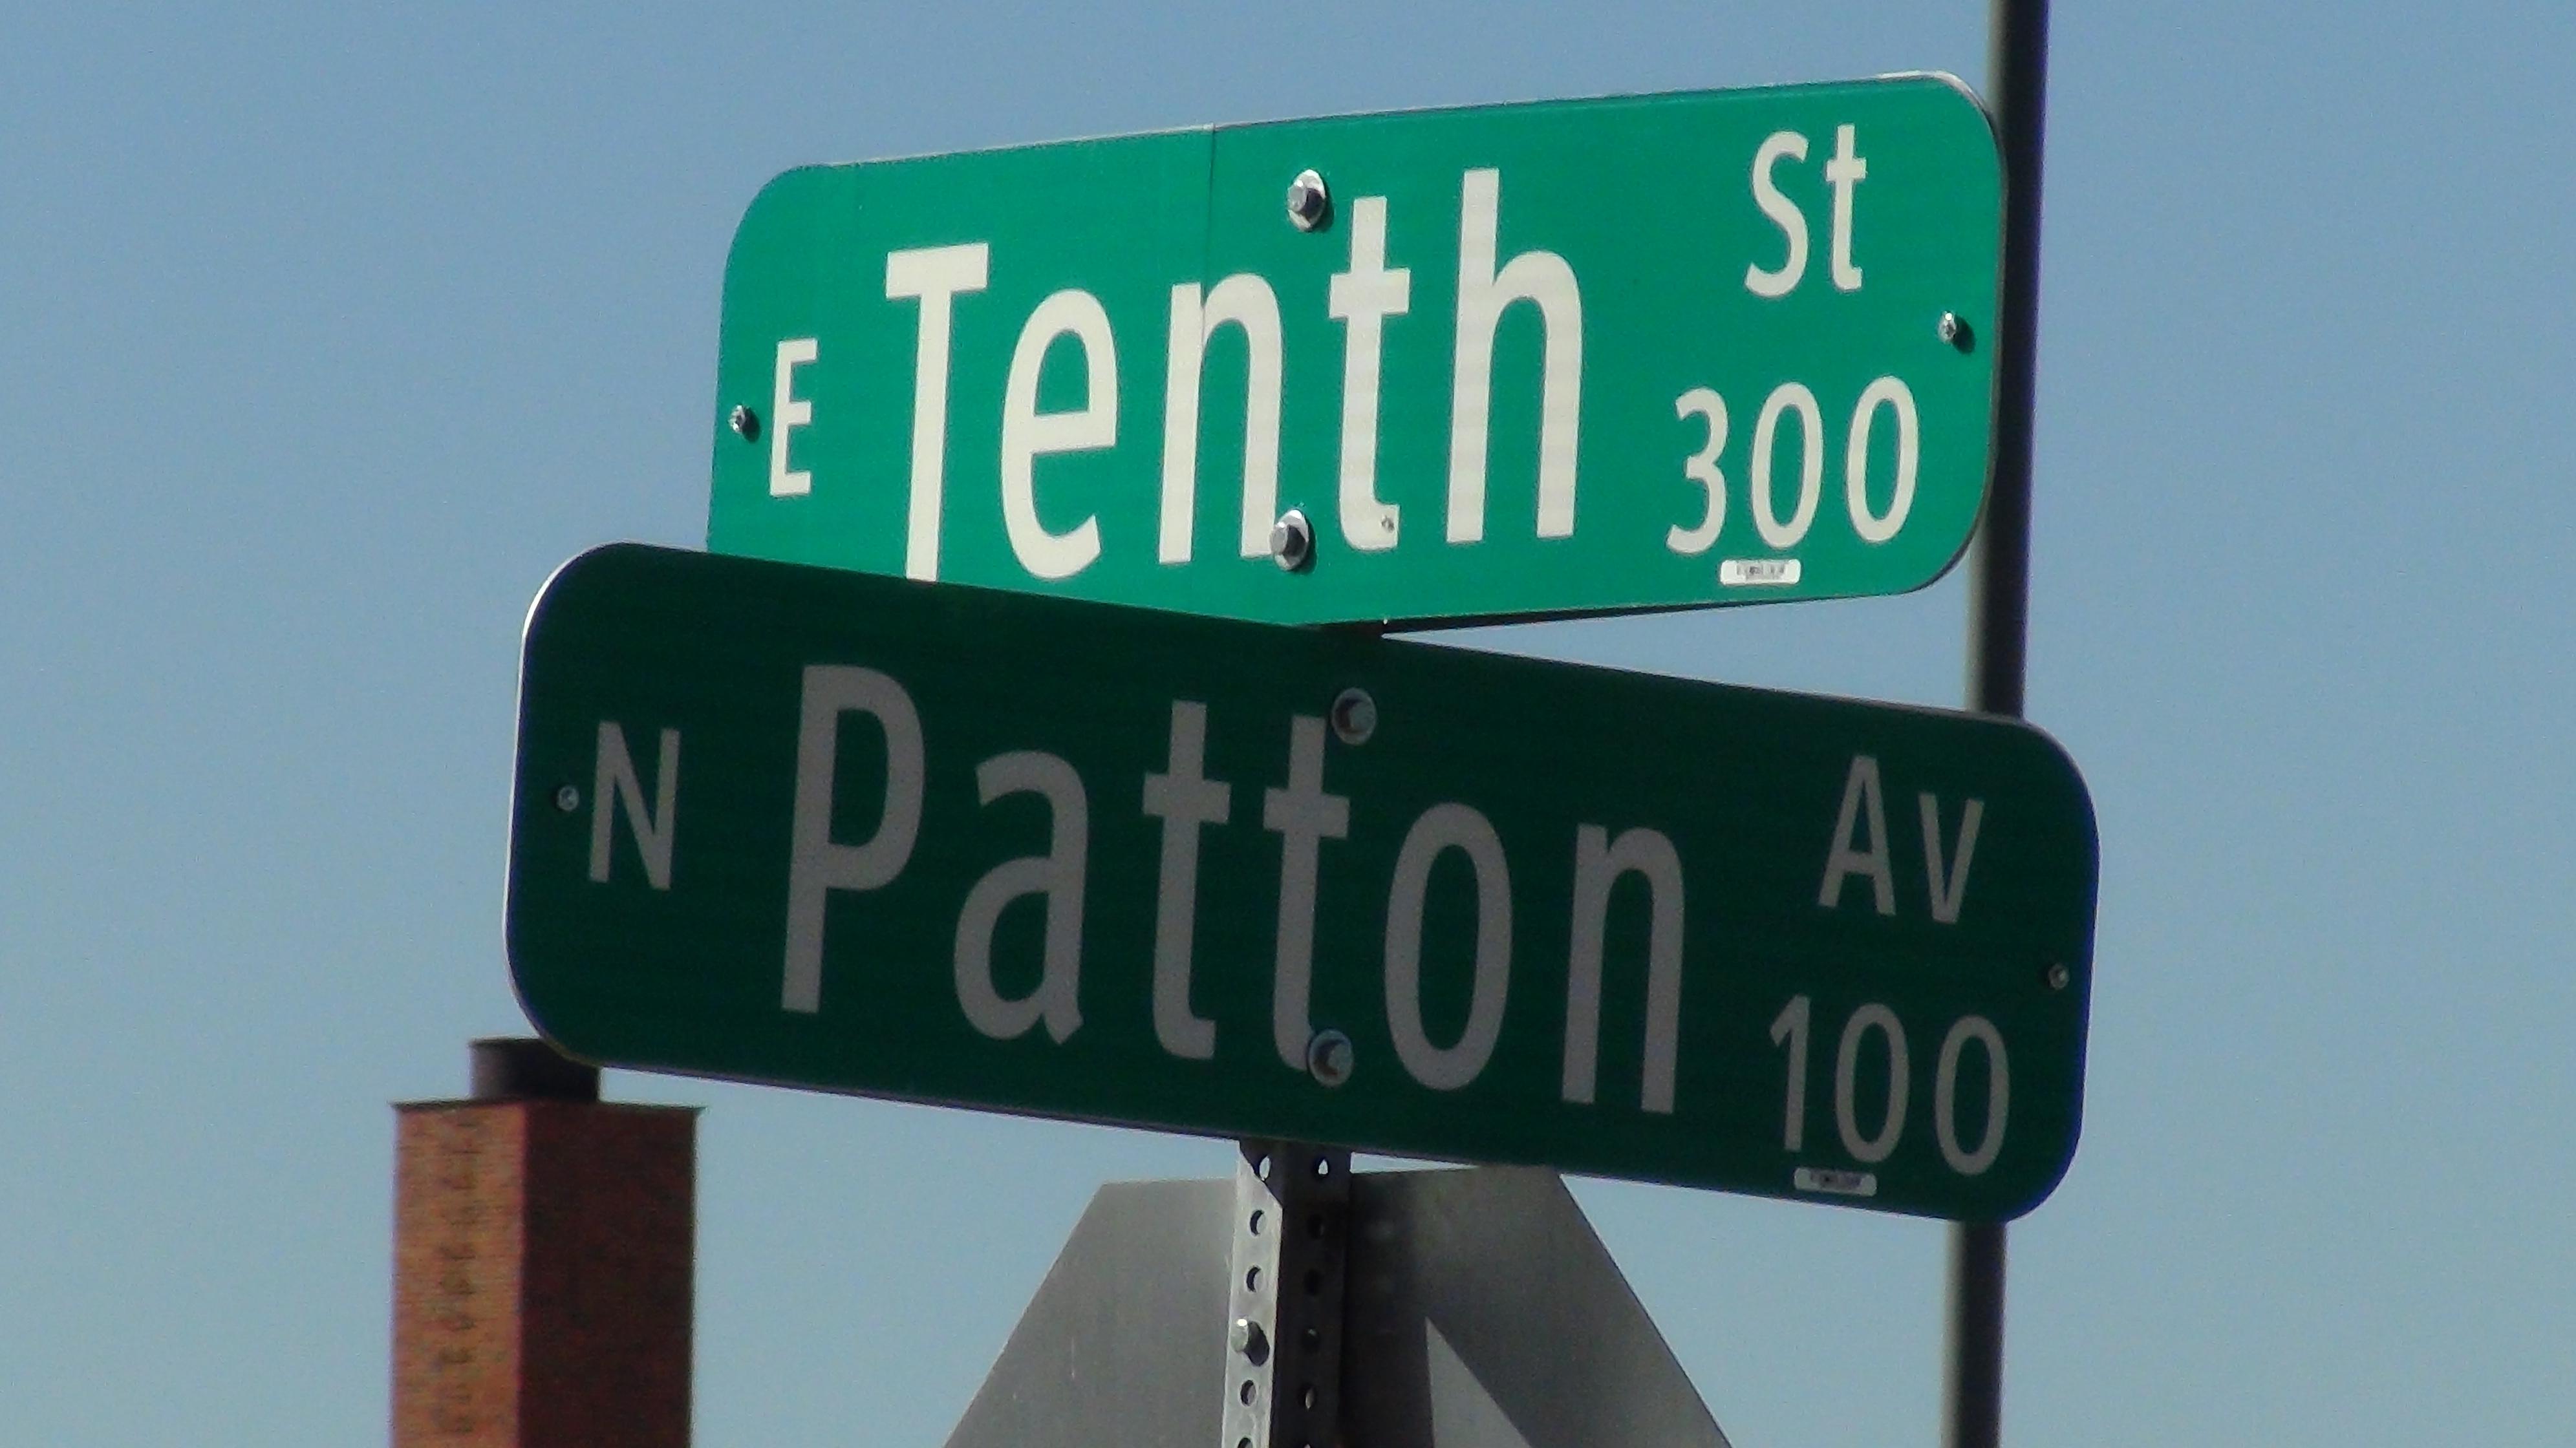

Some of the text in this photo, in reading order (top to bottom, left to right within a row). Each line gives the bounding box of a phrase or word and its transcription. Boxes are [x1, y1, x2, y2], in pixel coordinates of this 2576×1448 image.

[769, 124, 1869, 582] E Tenth St
[1666, 376, 1920, 555] 300
[589, 665, 1985, 1114] N Patton Av
[1770, 994, 2010, 1176] 100
